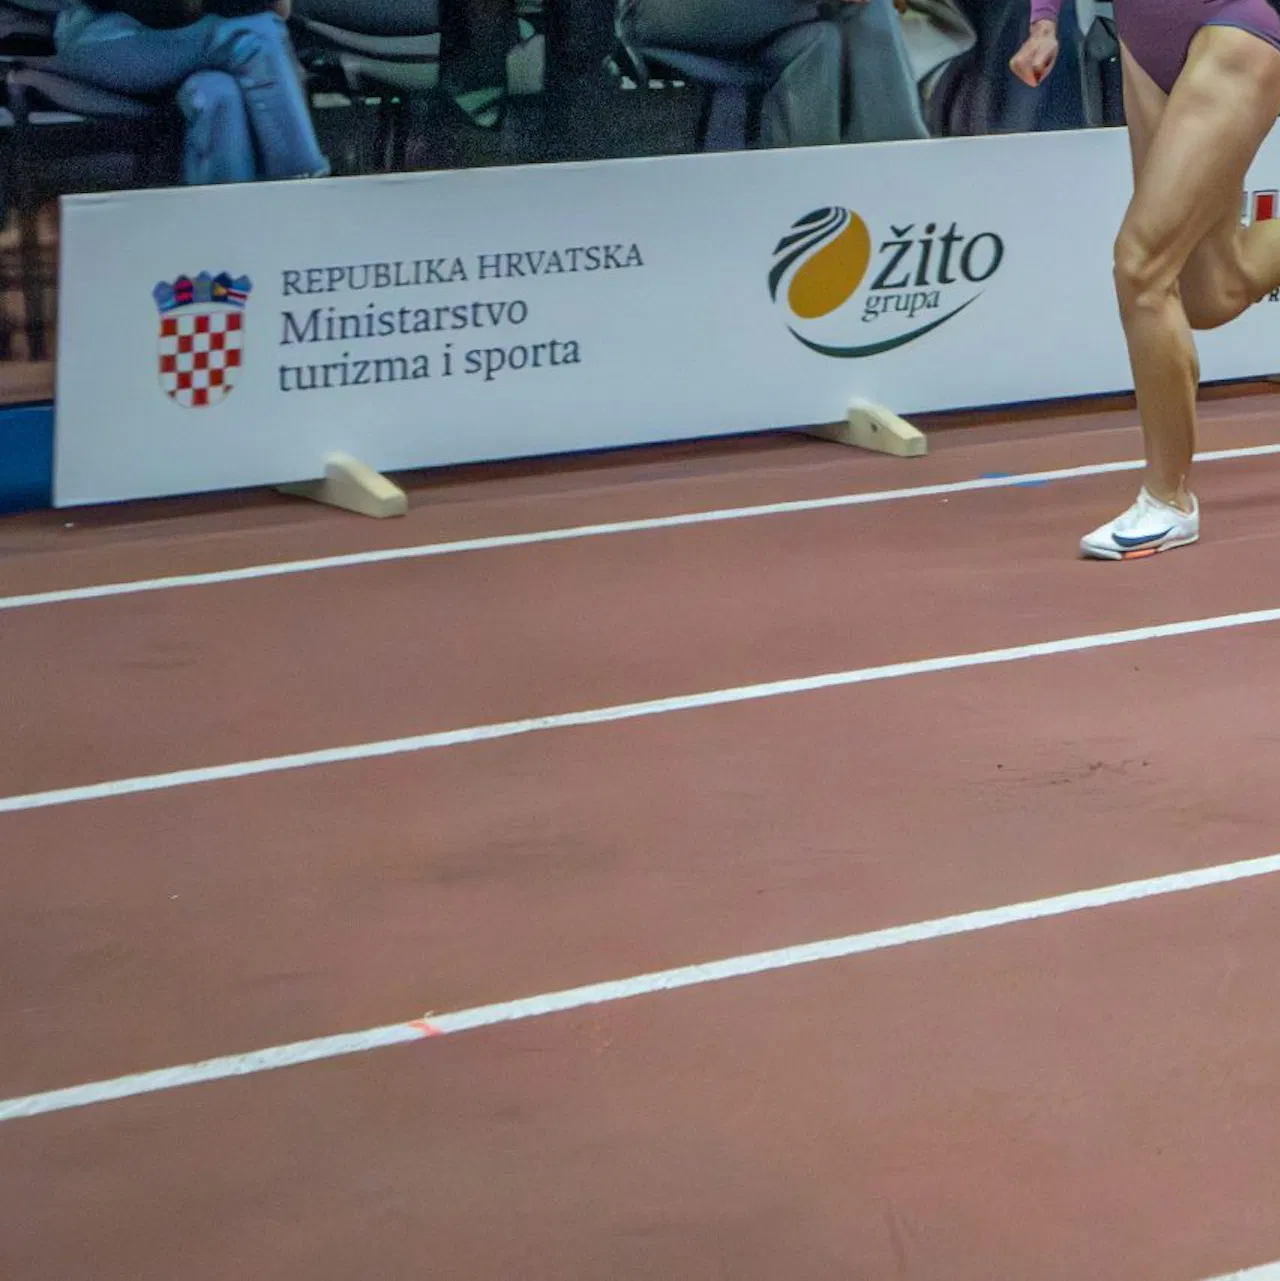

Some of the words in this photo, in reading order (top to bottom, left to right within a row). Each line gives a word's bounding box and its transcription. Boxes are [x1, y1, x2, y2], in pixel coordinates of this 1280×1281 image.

[281, 257, 468, 296] REPUBLIKA
[478, 243, 644, 279] HRVATSKA
[870, 222, 1004, 290] žito
[279, 298, 529, 346] Ministarstvo
[861, 290, 941, 322] grupa
[278, 349, 430, 392] turizma
[442, 344, 453, 377] i
[464, 335, 582, 381] sporta
